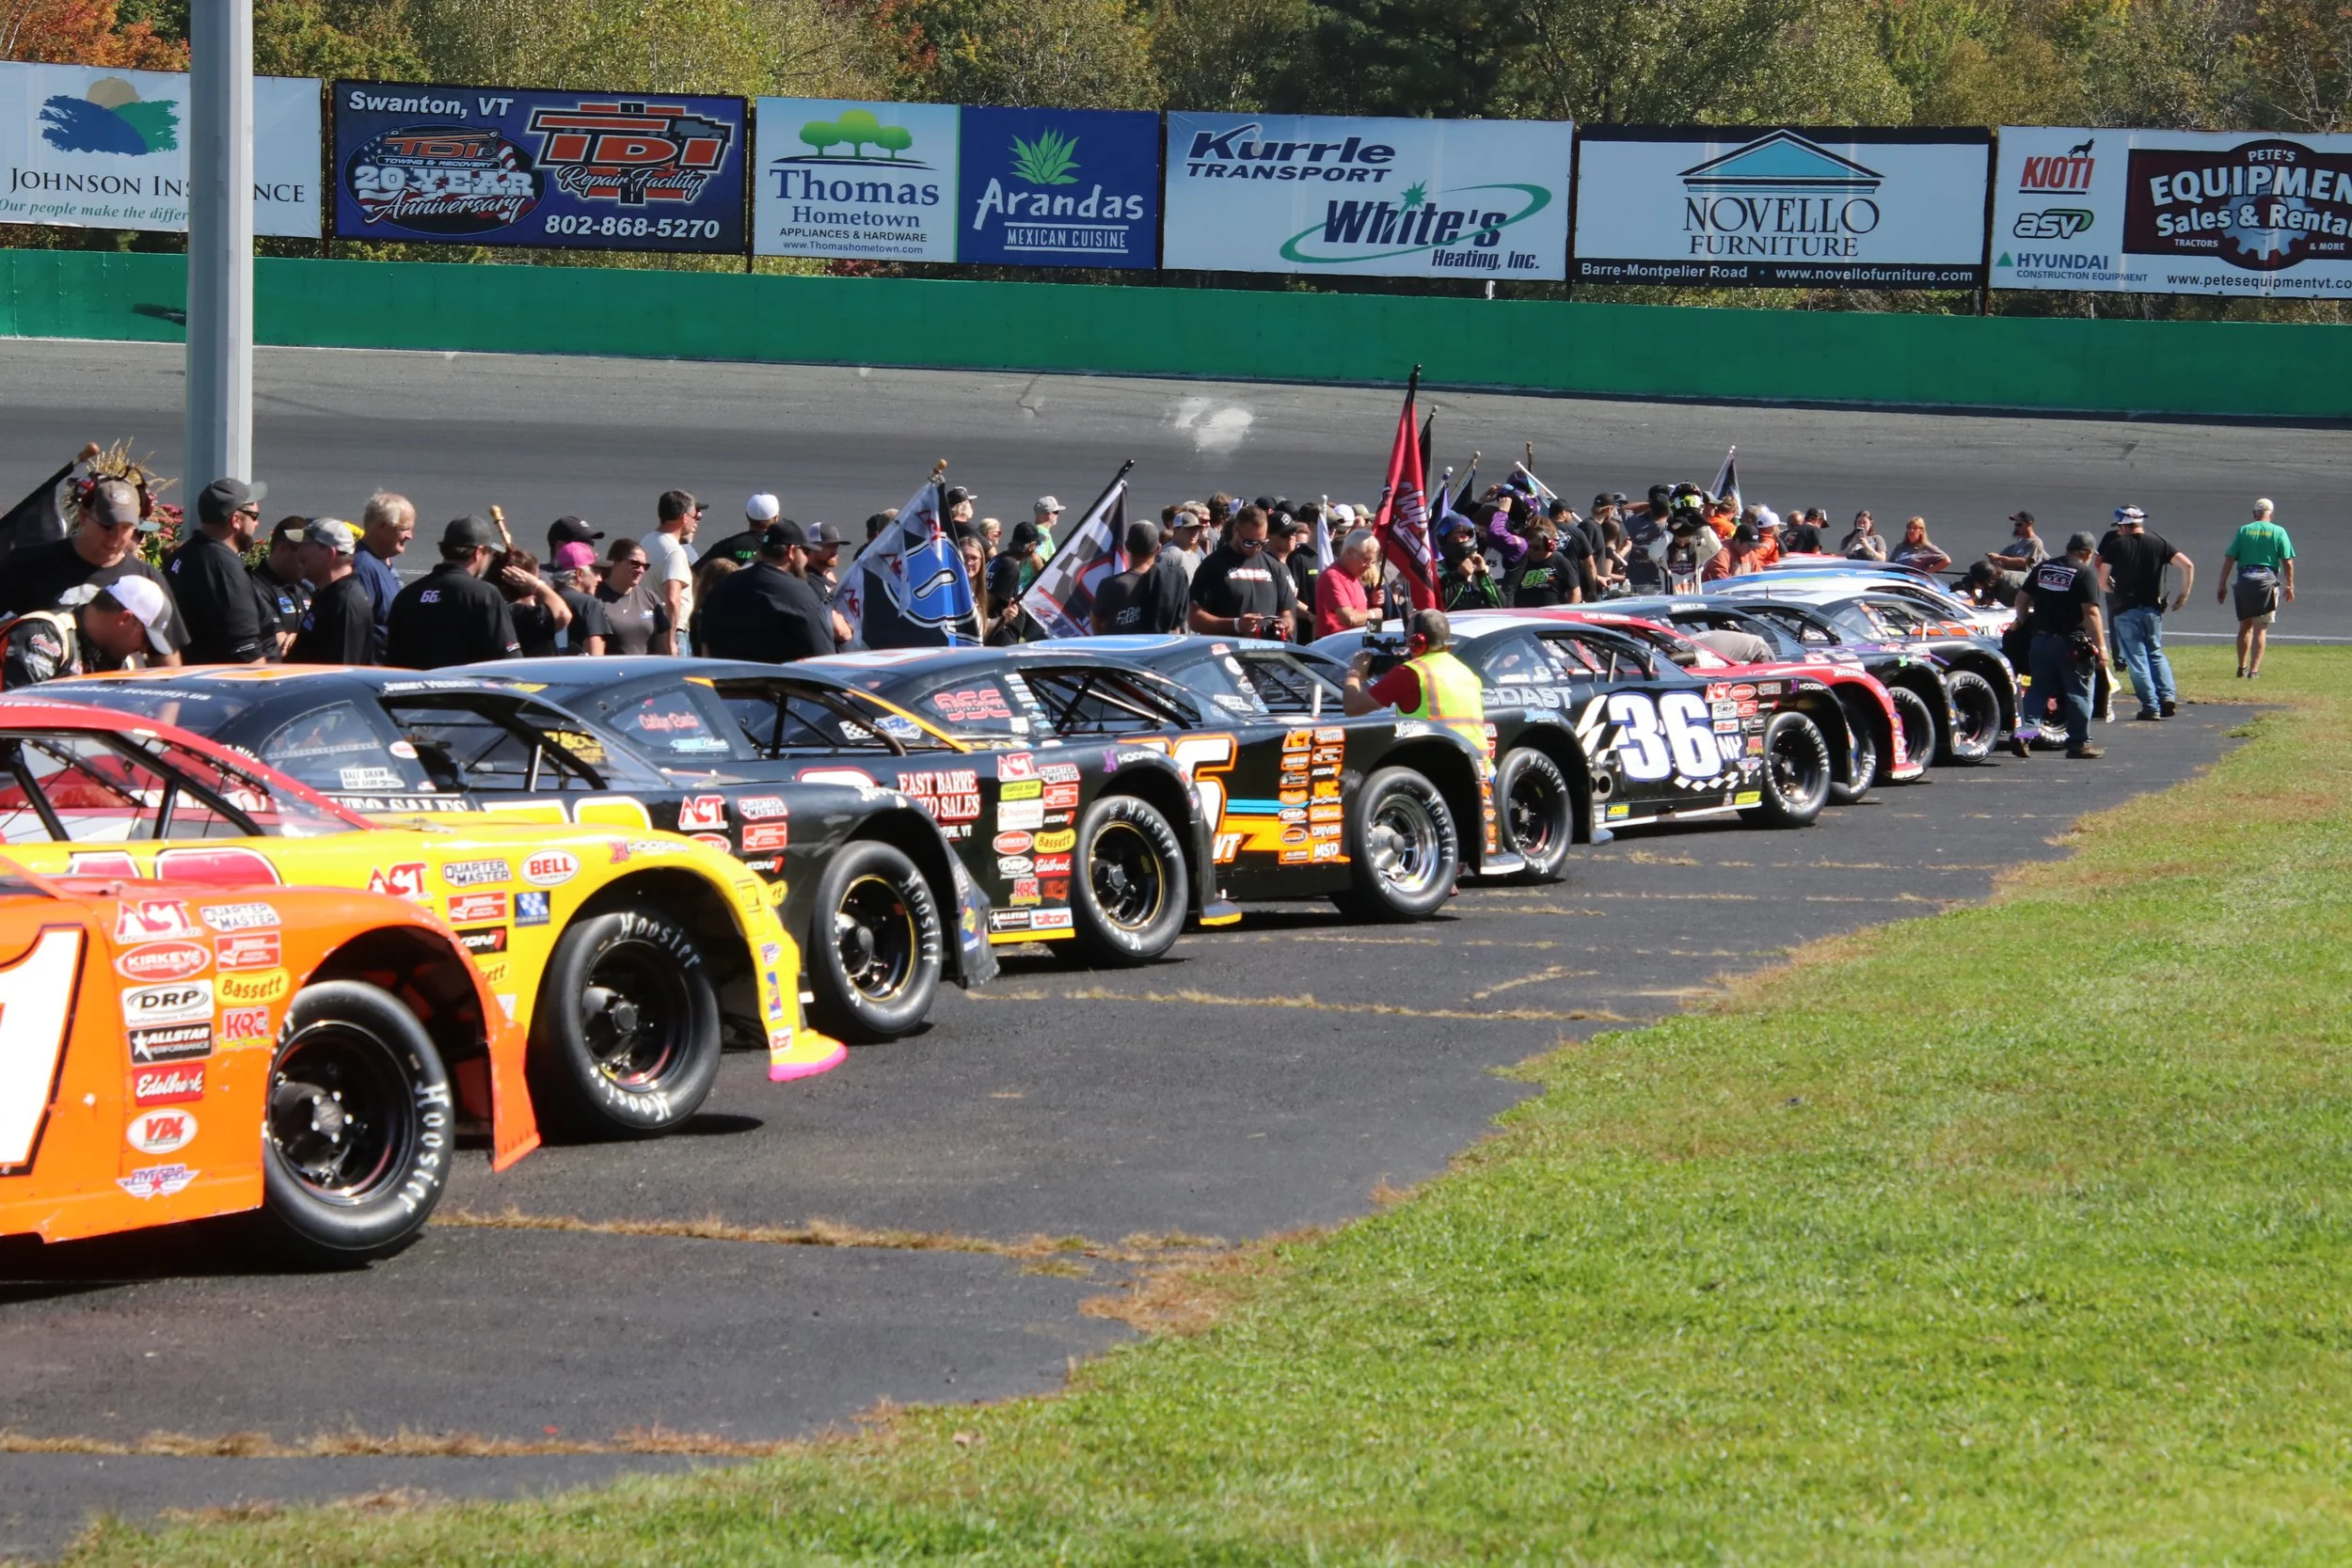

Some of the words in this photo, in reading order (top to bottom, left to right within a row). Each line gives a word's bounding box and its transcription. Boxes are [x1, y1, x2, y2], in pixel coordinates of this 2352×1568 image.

[349, 91, 468, 119] Swanton,
[479, 98, 514, 117] VT
[385, 135, 479, 158] TDI
[529, 106, 731, 170] TDI
[1188, 123, 1395, 164] Kurrle
[384, 157, 424, 166] TOWING
[437, 160, 494, 168] RECOVERY
[2248, 149, 2296, 163] PETE'S
[10, 167, 141, 195] JOHNSON
[355, 166, 406, 190] 20
[414, 168, 534, 197] YEAR
[562, 166, 629, 194] Repair
[631, 167, 707, 199] Facility
[1185, 162, 1392, 182] TRANSPORT
[2020, 156, 2095, 188] KIOTI
[770, 167, 939, 206] Thomas
[0, 198, 26, 213] Our
[29, 201, 77, 217] people
[81, 205, 120, 218] make
[122, 206, 147, 219] the
[365, 190, 526, 224] Anniversary
[973, 178, 1144, 230] Arandas
[791, 205, 921, 228] Hometown
[1324, 199, 1507, 247] White's
[1682, 197, 1881, 234] NOVELLO
[2155, 206, 2232, 237] Sales
[2239, 204, 2260, 227] &
[546, 215, 720, 239] 802-868-5270
[779, 227, 850, 240] APPLIANCES
[852, 230, 860, 240] &
[863, 230, 927, 242] HARDWARE
[1007, 229, 1068, 246] MEXICAN
[1072, 231, 1127, 247] CUISINE
[783, 241, 923, 254] www.Thomashometown.com
[1689, 235, 1859, 257] FURNITURE
[2175, 239, 2218, 248] TRACTORS
[1432, 249, 1502, 271] Heating,
[1507, 251, 1540, 269] Inc.
[1581, 262, 1708, 278] Barre-Montpelier
[1710, 266, 1747, 278] Road
[2017, 253, 2108, 270] HYUNDAI
[1776, 267, 1973, 281] www.novellofurniture.com
[2017, 270, 2090, 280] CONSTRUCTION
[2092, 272, 2148, 282] EQUIPMENT
[1605, 690, 1724, 783] 36
[1716, 734, 1743, 760] NY
[898, 772, 934, 796] EAST
[935, 769, 978, 794] BARRE
[941, 794, 981, 818] SALES
[1038, 834, 1071, 847] Bassett
[1312, 825, 1341, 836] DRIVEN
[1314, 842, 1340, 857] MSD
[444, 860, 506, 879] QUARTER
[530, 857, 573, 876] BELL
[1035, 858, 1071, 873] Edelbrock
[456, 870, 510, 885] MASTER
[898, 870, 941, 966] Hoosier
[1034, 912, 1070, 927] tilton
[614, 911, 702, 969] Hoosier
[221, 974, 283, 999] Bassett
[141, 990, 199, 1009] DRP
[147, 1026, 211, 1043] ALLSTAR
[398, 1080, 450, 1214] Hoosier
